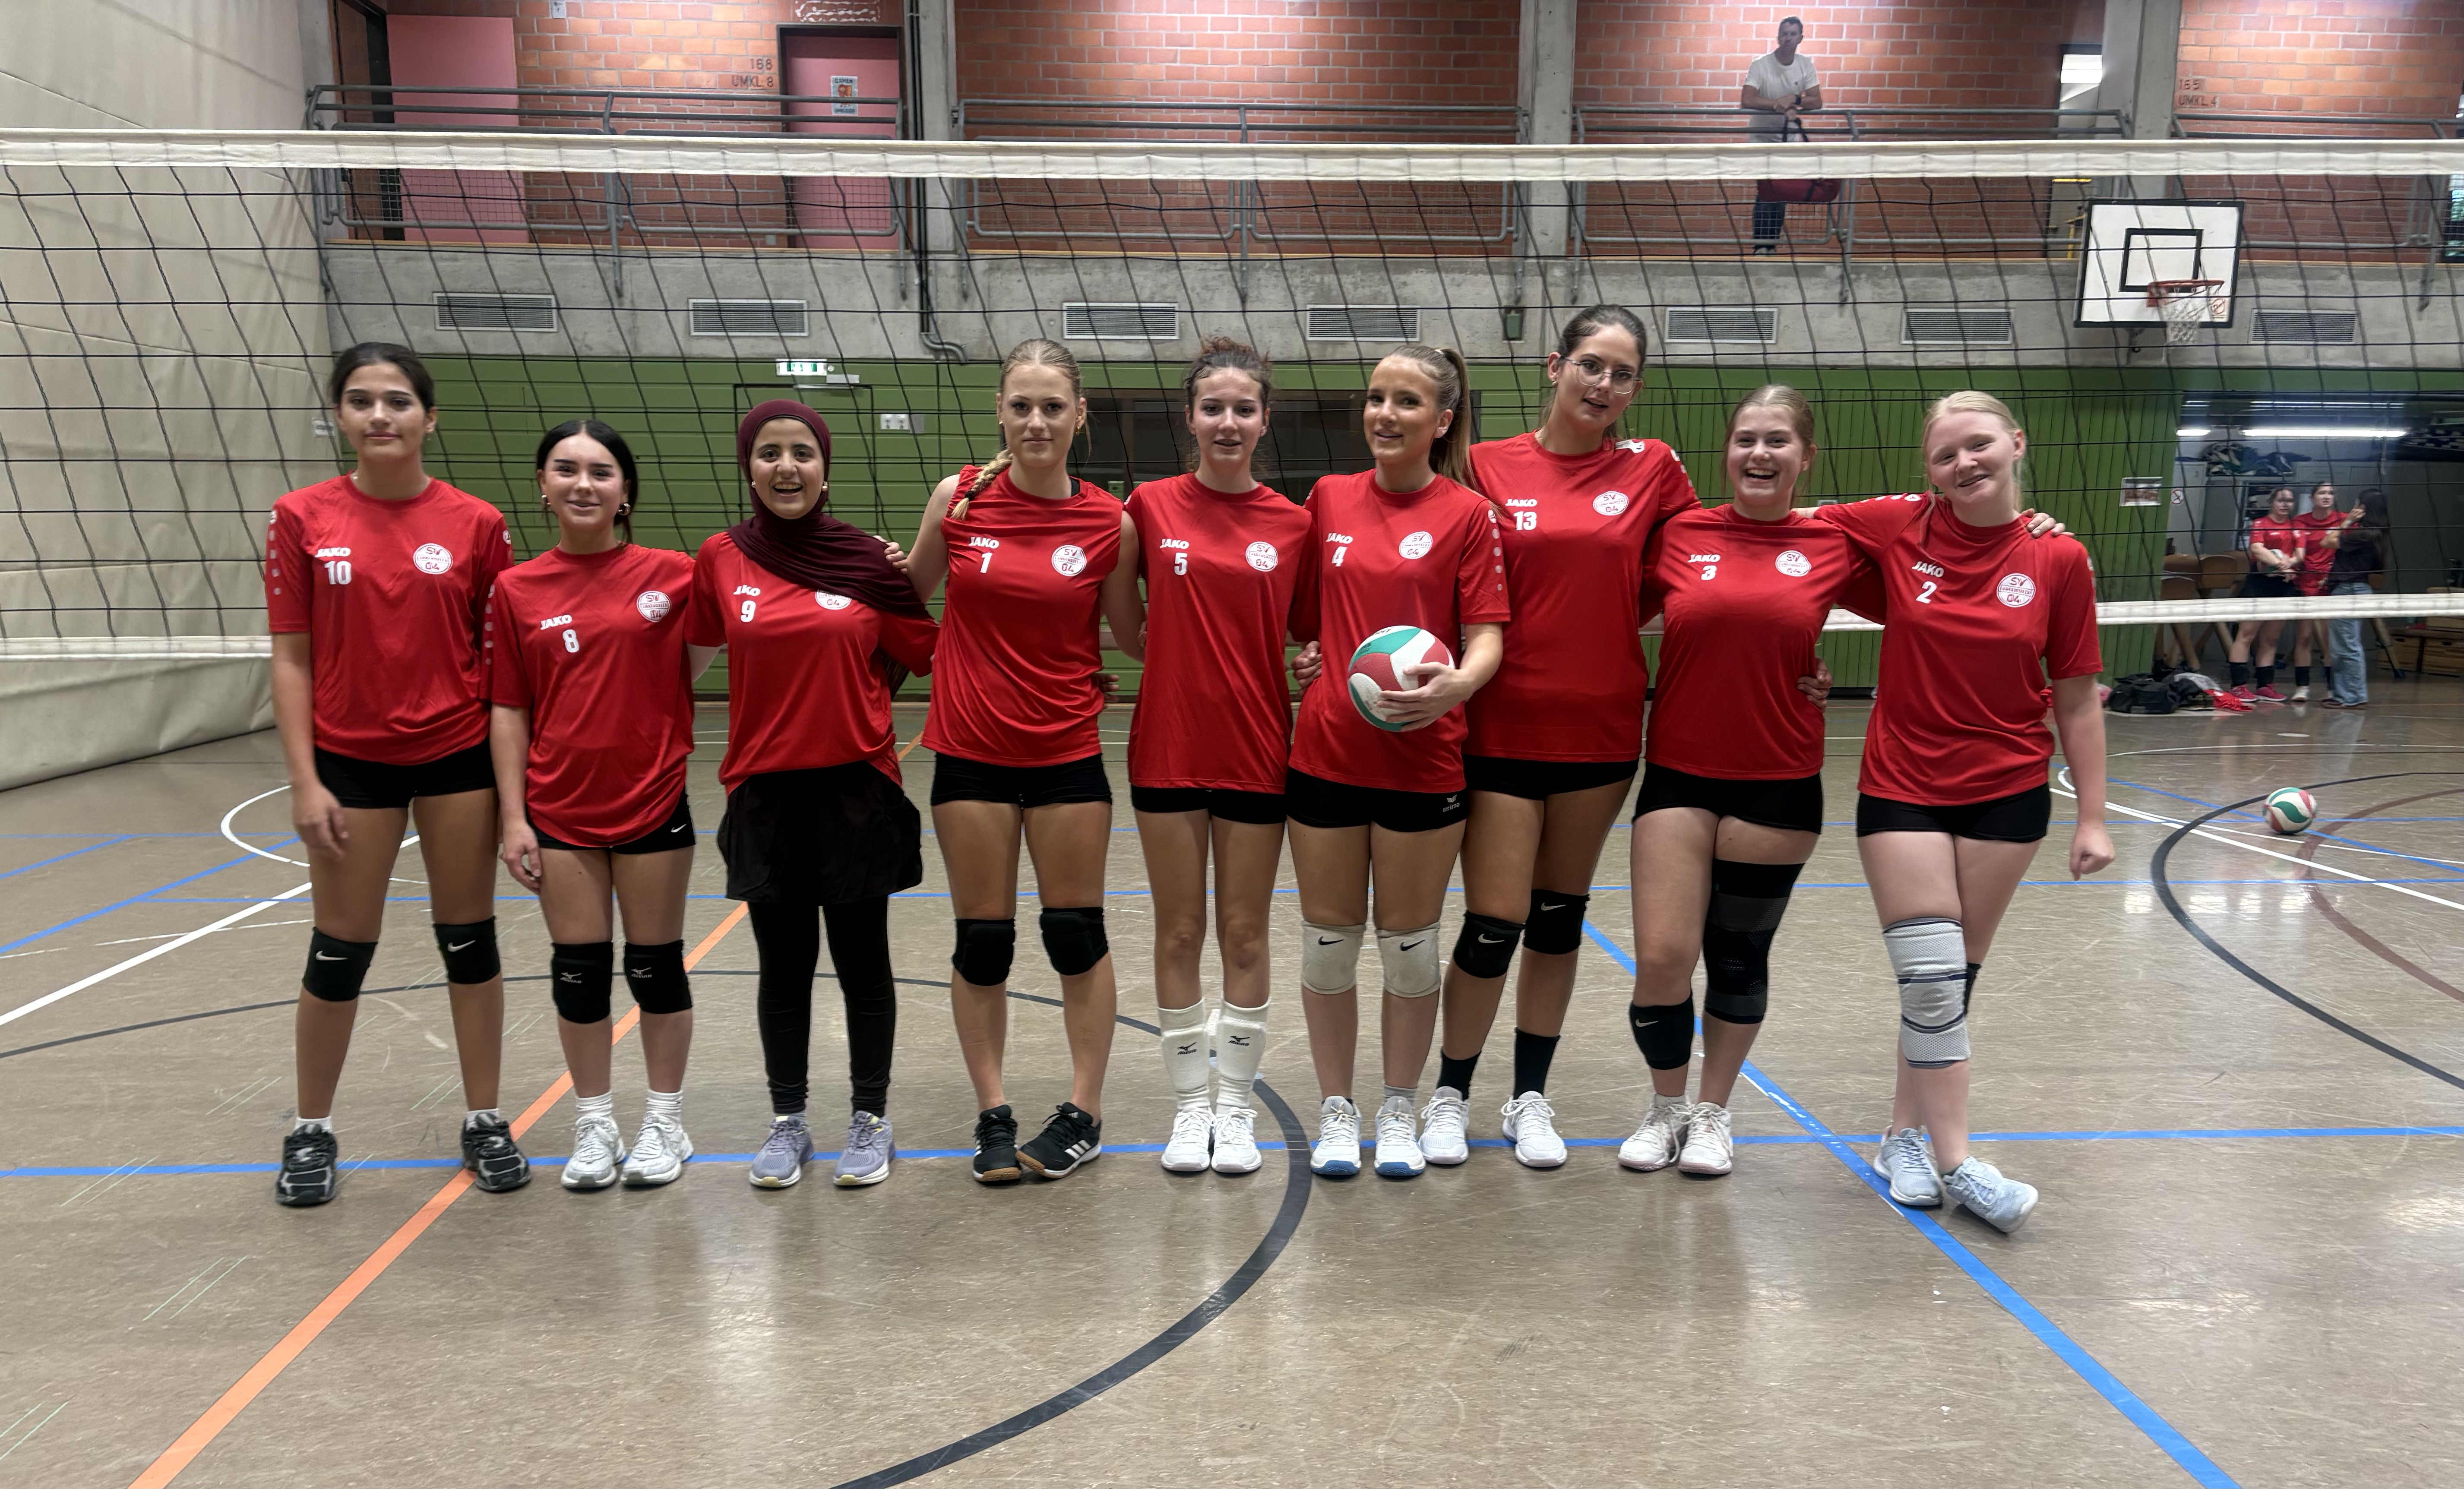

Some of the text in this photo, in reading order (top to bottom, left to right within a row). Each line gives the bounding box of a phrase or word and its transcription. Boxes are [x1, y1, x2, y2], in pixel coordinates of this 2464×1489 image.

[750, 58, 773, 70] 168
[767, 76, 774, 87] 8
[2211, 95, 2218, 105] 4
[1505, 499, 1537, 507] JAKO
[1513, 511, 1537, 531] 13
[968, 537, 999, 549] JAKO
[1160, 538, 1189, 549] JAKO
[1325, 533, 1353, 544] JAKO
[315, 547, 351, 557] JAKO
[1331, 546, 1347, 567] 4
[980, 552, 993, 573] 1
[1174, 552, 1188, 575] 5
[1687, 554, 1721, 563] JAKO
[324, 561, 352, 585] 10
[1062, 563, 1074, 572] 04
[1701, 565, 1717, 581] 3
[1911, 561, 1944, 577] JAKO
[2009, 577, 2028, 586] SV
[733, 585, 761, 596] JKO
[1916, 581, 1937, 604] 2
[2007, 594, 2021, 603] 04
[740, 600, 756, 622] 9
[540, 614, 572, 630] JAKO
[563, 629, 579, 653] 8
[1442, 803, 1460, 812] erima
